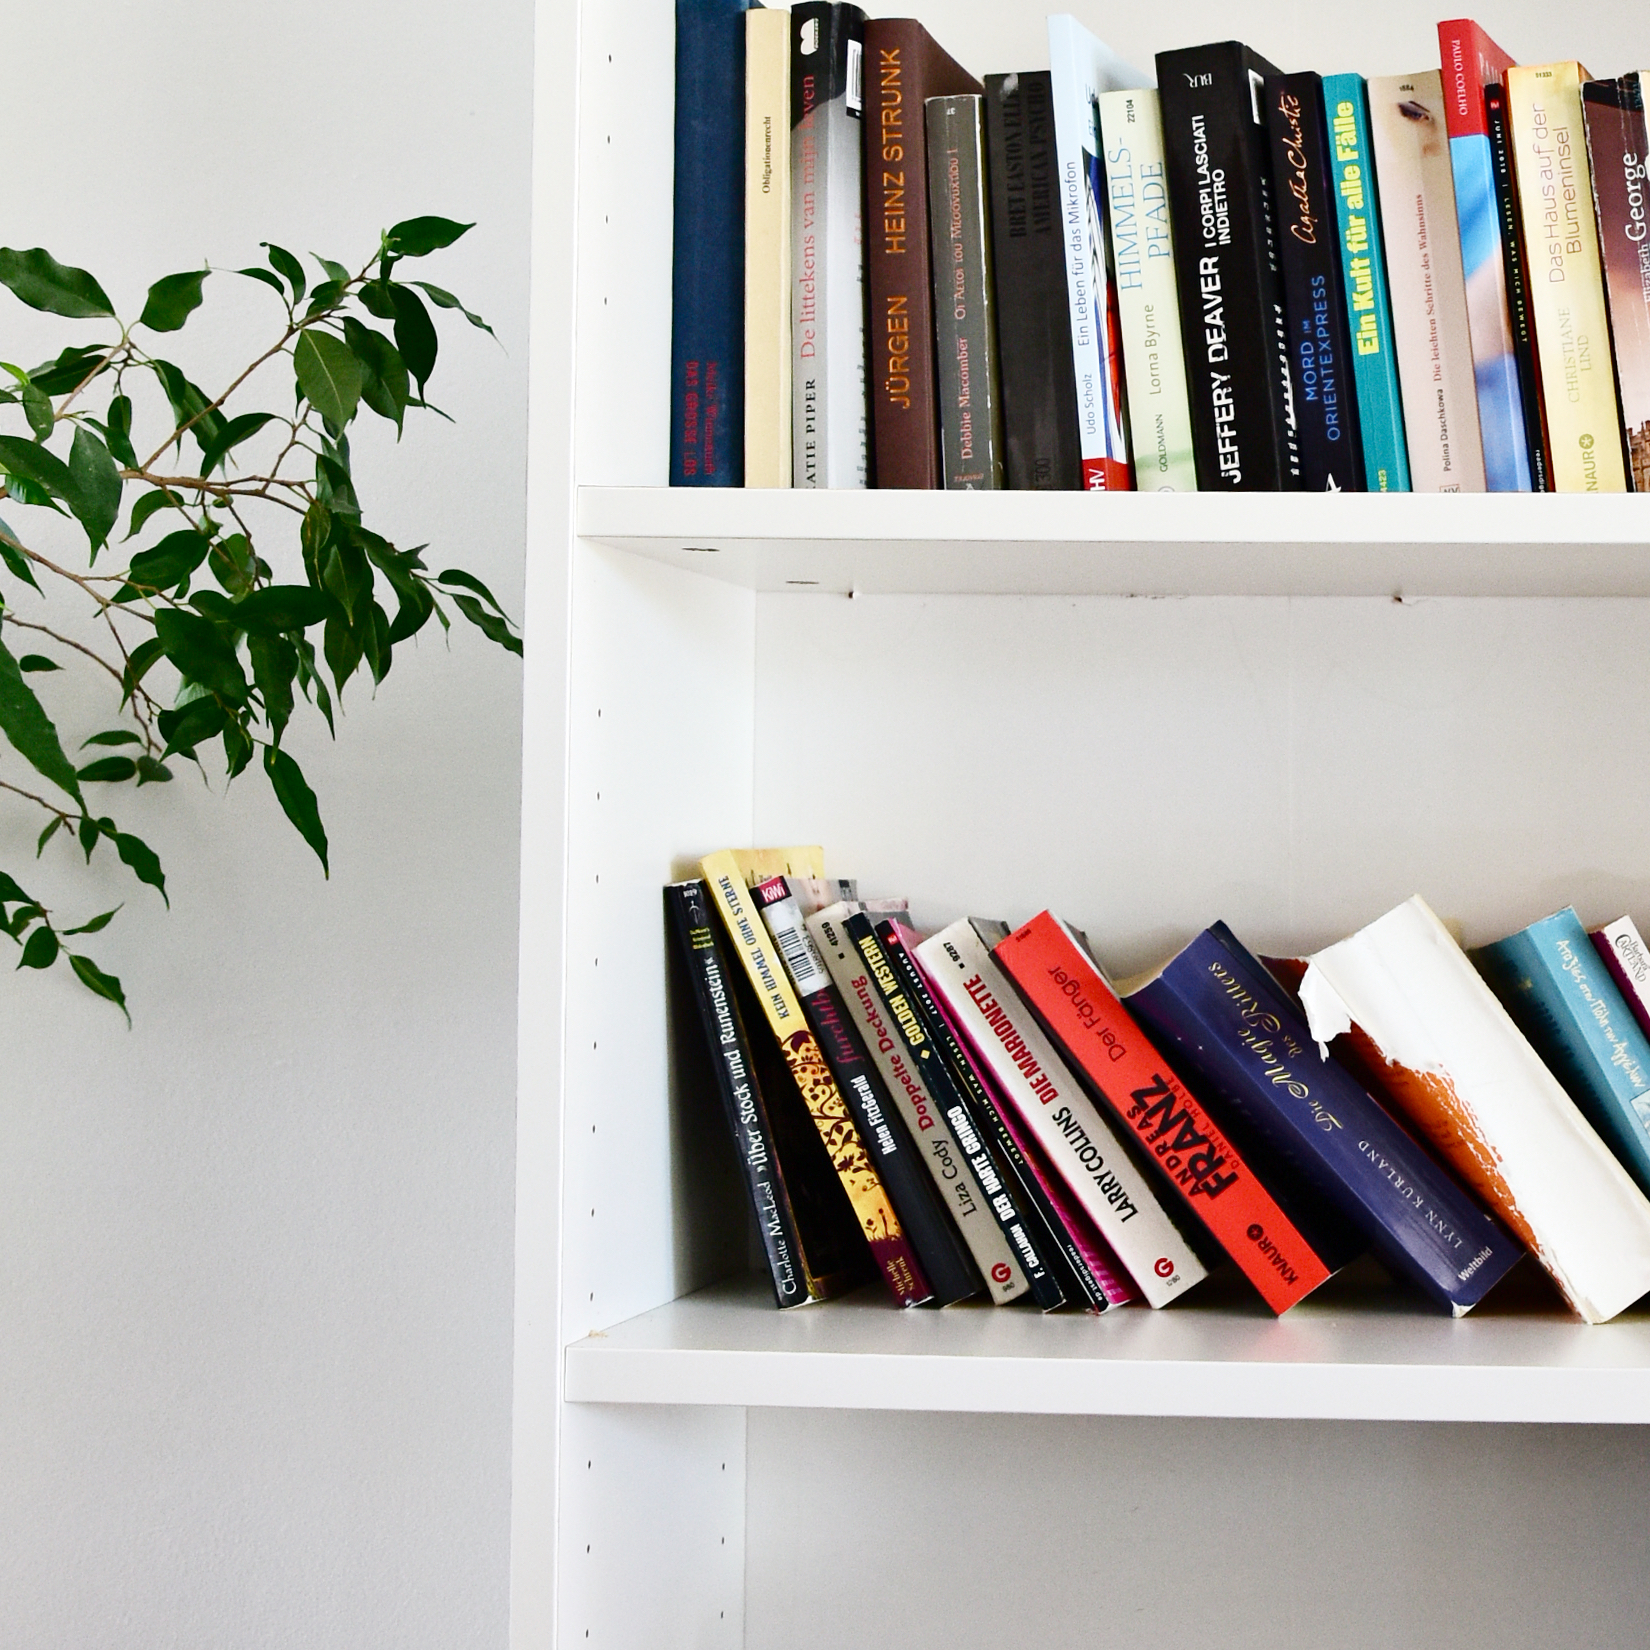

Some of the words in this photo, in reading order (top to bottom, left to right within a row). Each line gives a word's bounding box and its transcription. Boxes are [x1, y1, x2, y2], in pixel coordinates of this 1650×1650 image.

[1451, 39, 1463, 76] PAULO
[880, 49, 904, 163] STRUNK
[1453, 79, 1468, 116] COELHO
[1337, 100, 1358, 161] Fälle
[884, 171, 905, 254] HEINZ
[1108, 136, 1142, 291] HIMMELS-
[1141, 161, 1171, 259] PFADE
[1213, 168, 1231, 247] INDIETRO
[1342, 163, 1363, 207] alle
[1625, 151, 1646, 243] George
[1346, 209, 1366, 251] für
[1201, 256, 1229, 363] DEAVER
[1351, 254, 1375, 317] Kult
[885, 296, 910, 409] JÜRGEN
[1301, 341, 1318, 401] MORD
[1311, 274, 1341, 442] ORIENTEXPRESS
[1357, 320, 1380, 357] Ein
[1211, 372, 1241, 484] JEFFERY
[963, 974, 1046, 1083] MARIONETTE
[1047, 964, 1104, 1030] Fänger
[1096, 1029, 1126, 1063] Der
[1030, 1074, 1060, 1105] DIE
[1052, 1107, 1104, 1172] COLLINS
[1126, 1105, 1201, 1198] ANDREAS
[1129, 1073, 1239, 1201] FRANZ
[1097, 1169, 1138, 1223] LARRY
[1260, 1238, 1298, 1286] KNAUR
[1458, 1246, 1493, 1282] Weltbild
